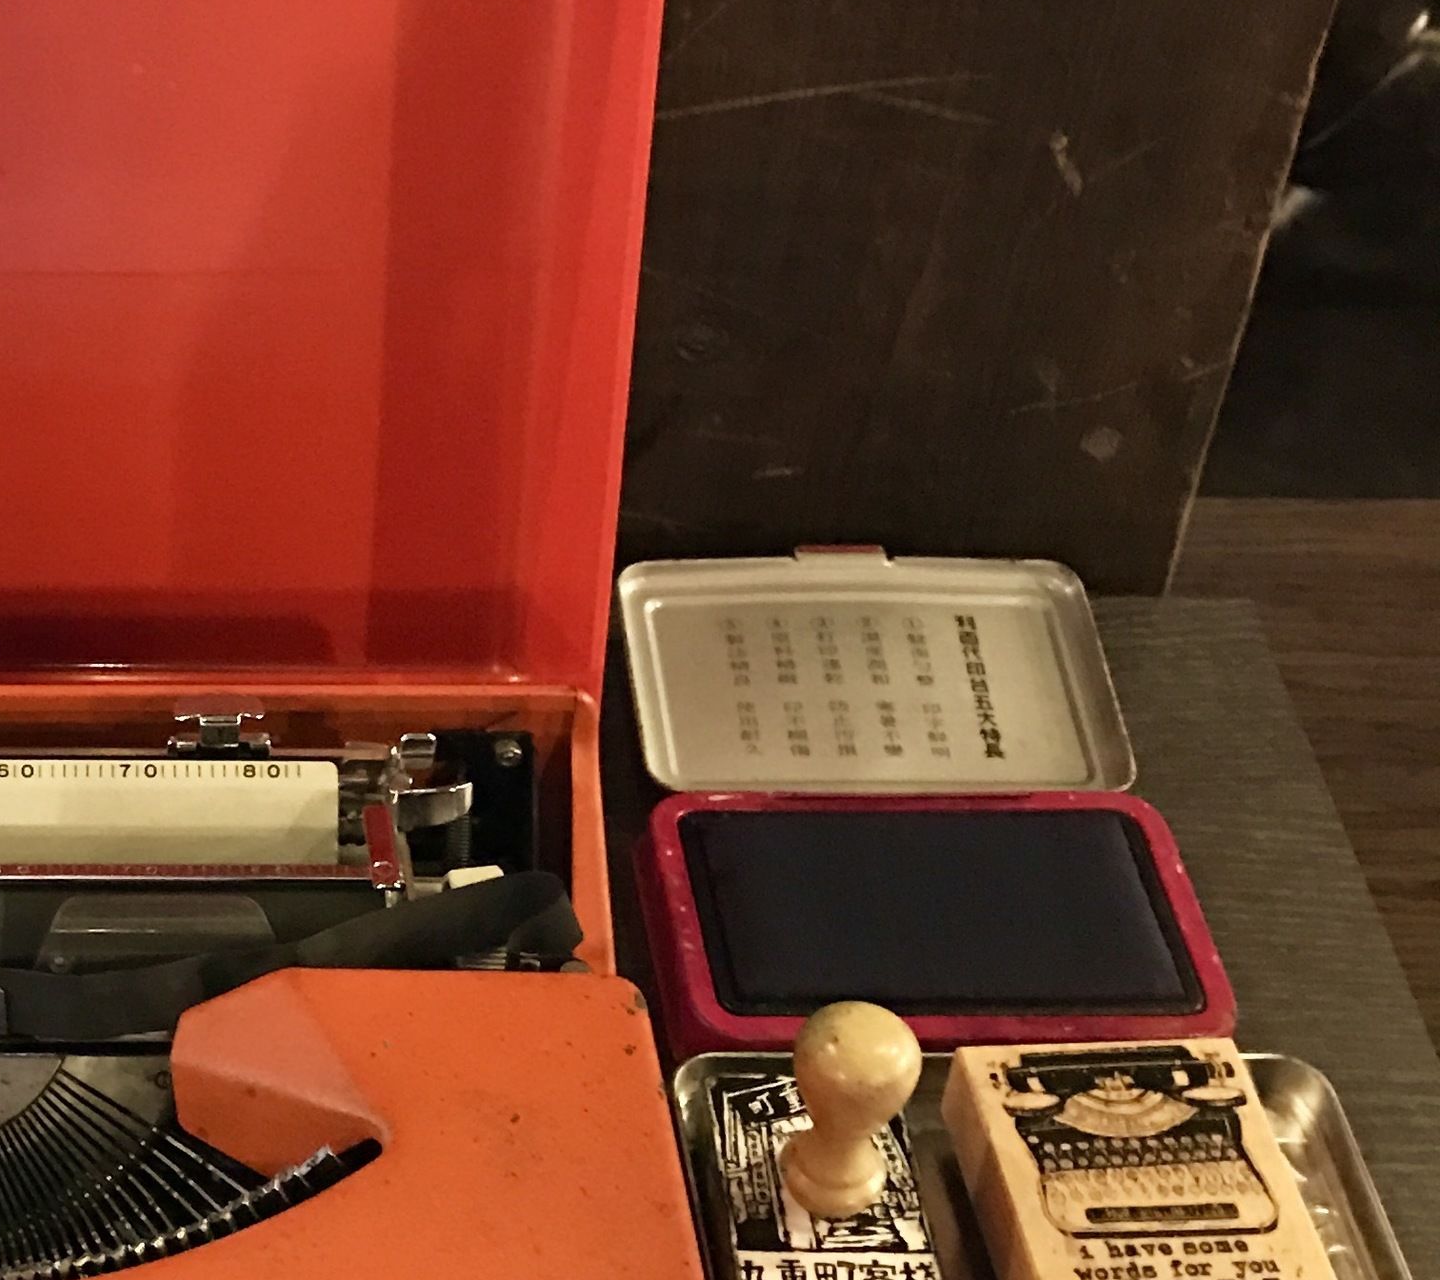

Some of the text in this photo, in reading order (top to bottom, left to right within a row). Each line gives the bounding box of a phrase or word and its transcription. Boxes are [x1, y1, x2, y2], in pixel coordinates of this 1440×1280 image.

[118, 763, 158, 779] 70
[242, 763, 281, 779] 80
[1105, 1240, 1174, 1258] have
[1182, 1239, 1249, 1255] some
[1169, 1259, 1213, 1278] for
[1231, 1259, 1281, 1280] you
